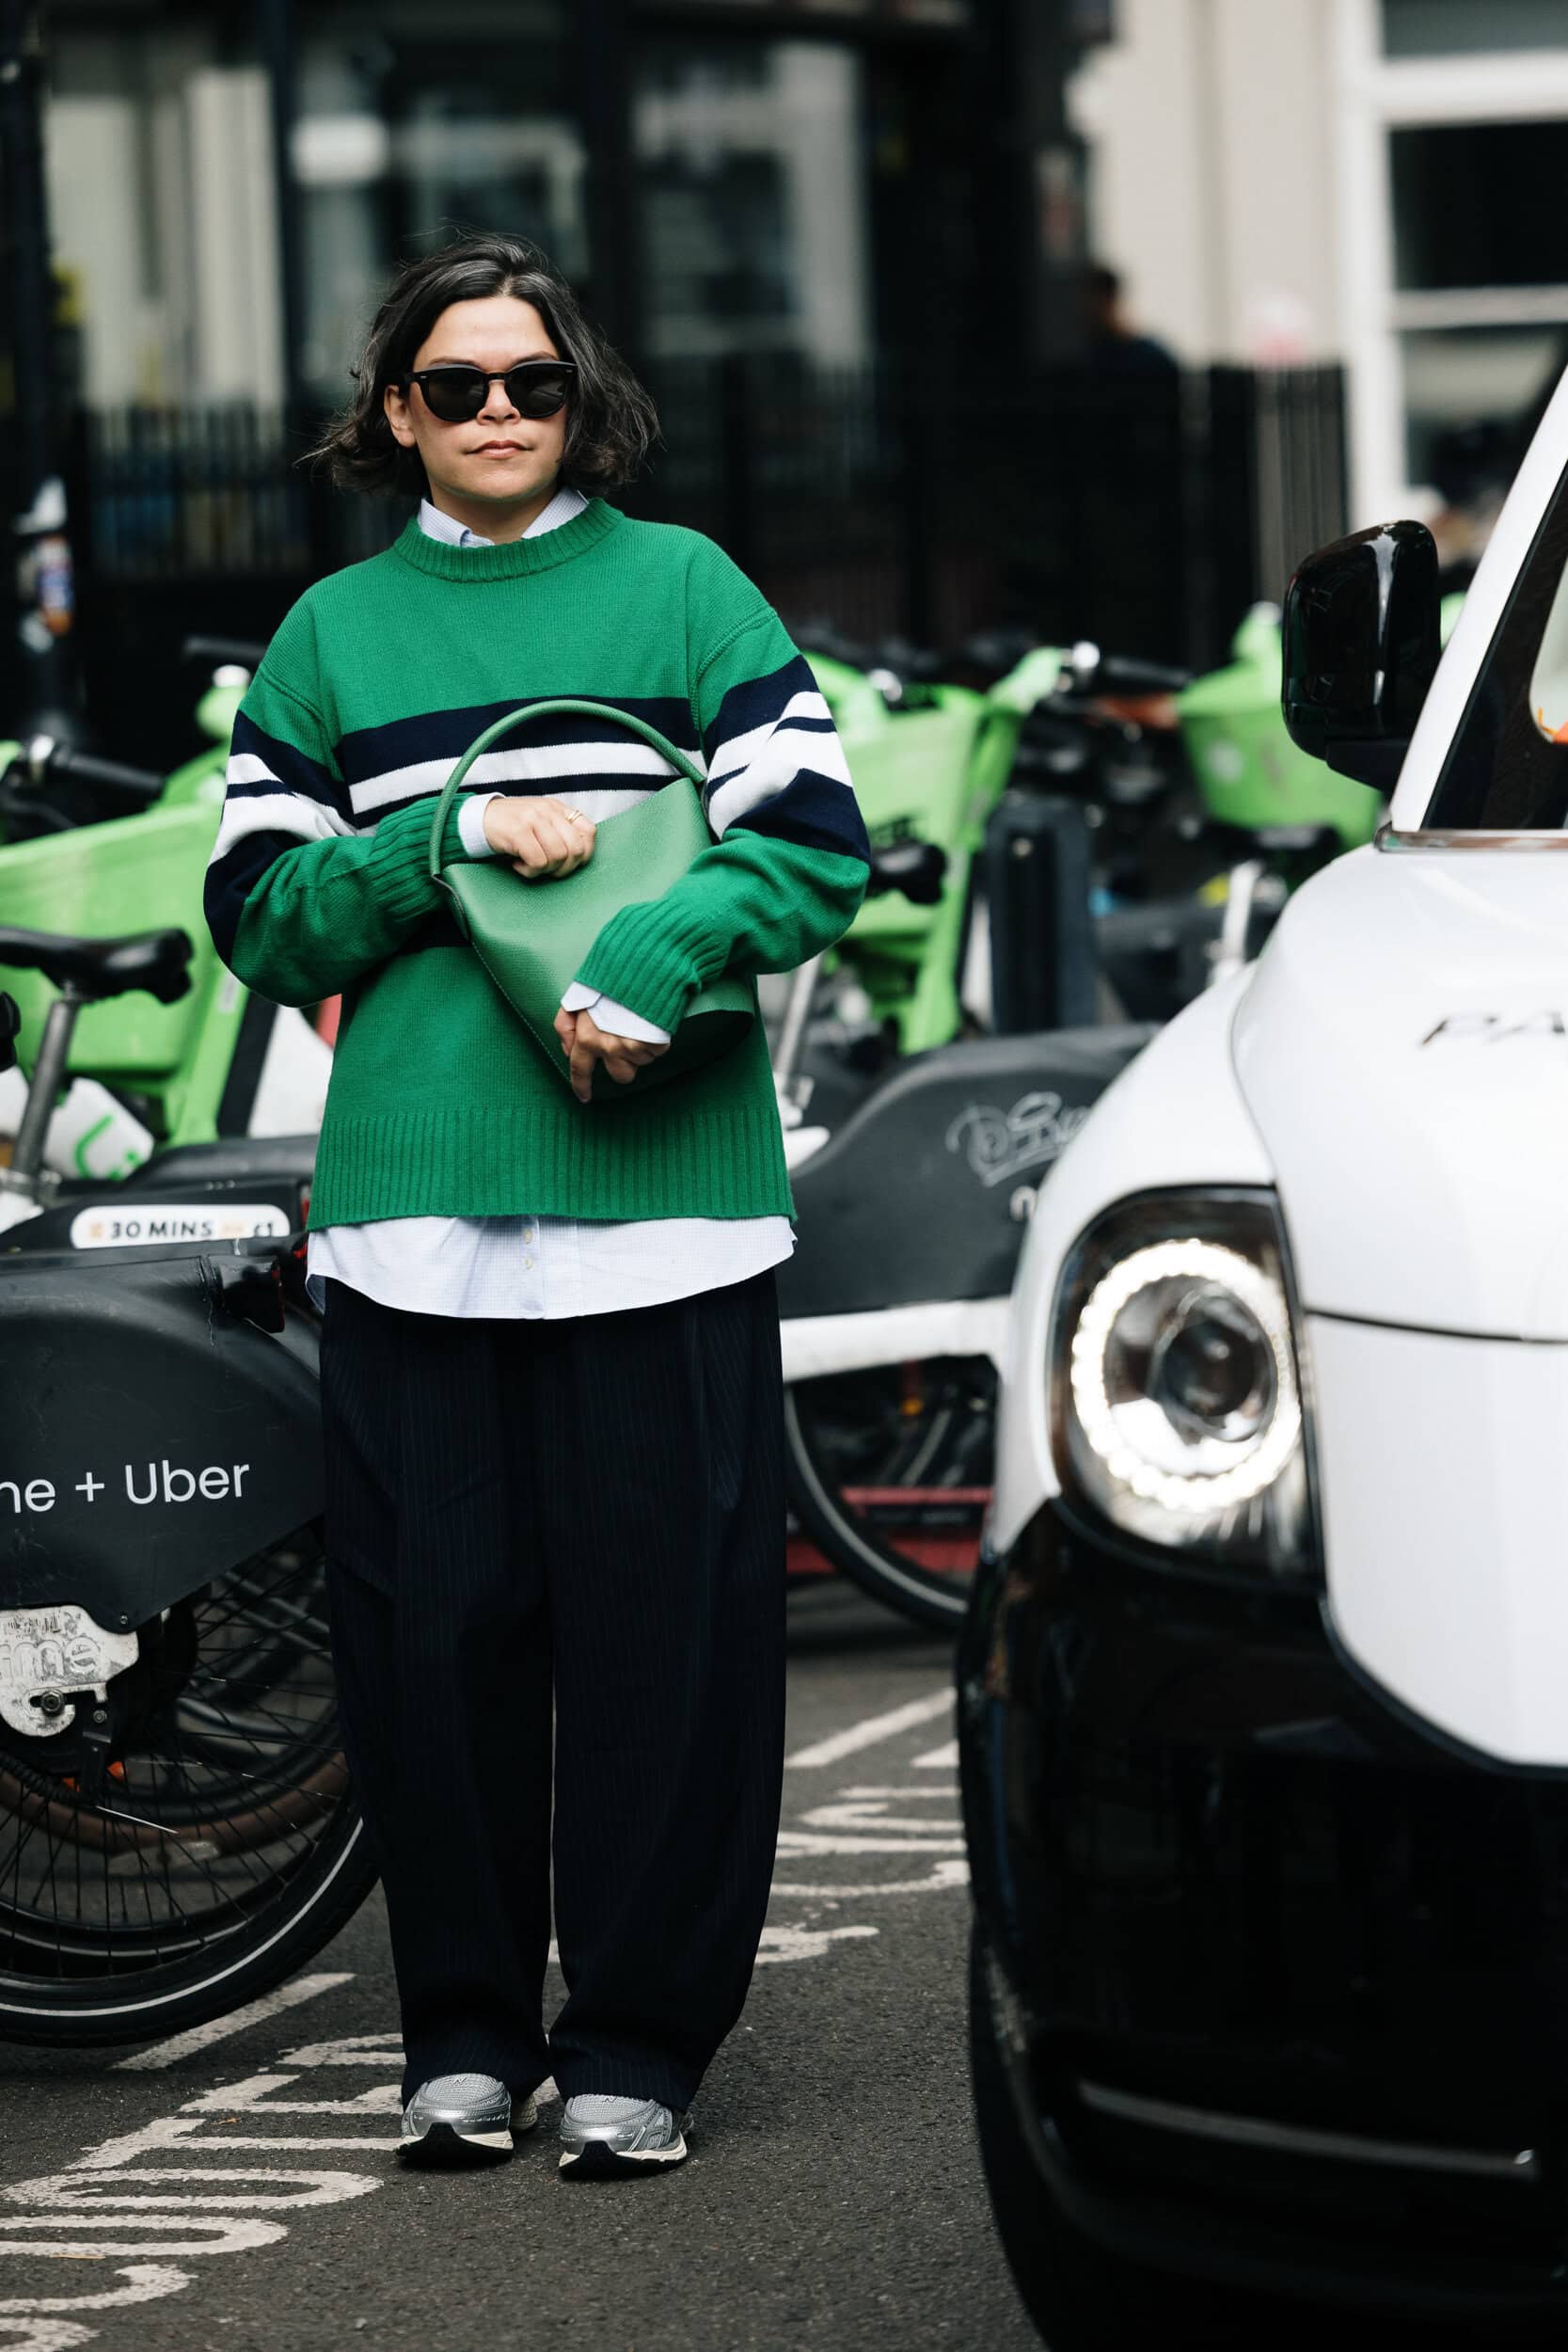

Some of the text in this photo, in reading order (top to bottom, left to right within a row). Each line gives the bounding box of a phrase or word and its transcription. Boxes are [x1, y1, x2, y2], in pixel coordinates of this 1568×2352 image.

[111, 1221, 141, 1239] 30
[149, 1221, 212, 1237] MINS
[124, 1459, 250, 1504] Uber
